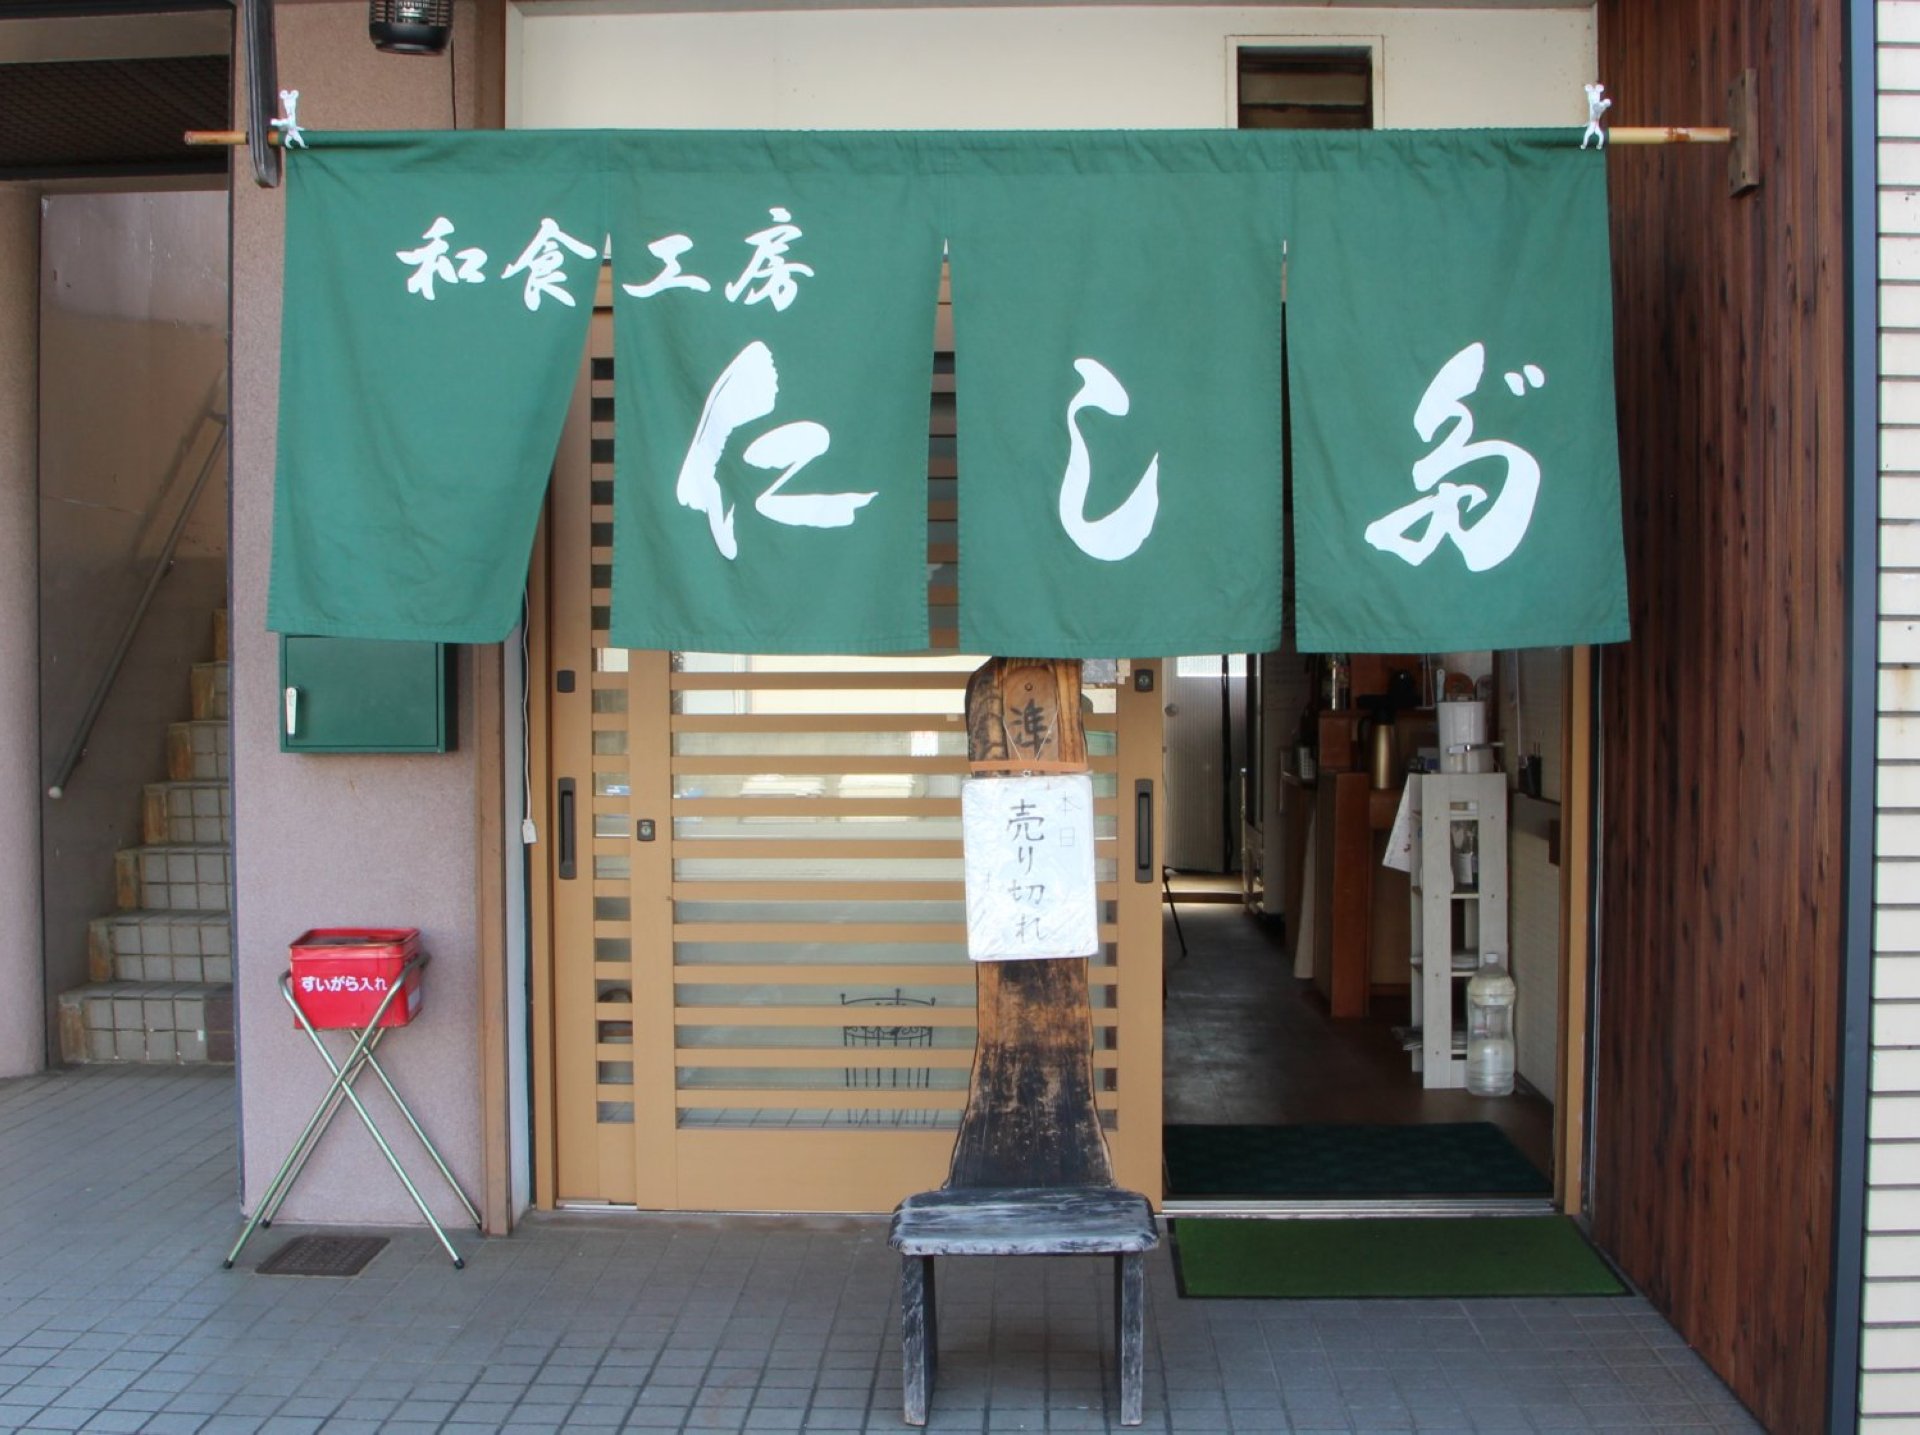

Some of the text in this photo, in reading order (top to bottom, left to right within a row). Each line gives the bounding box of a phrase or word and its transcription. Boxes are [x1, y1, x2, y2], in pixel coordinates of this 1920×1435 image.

[396, 207, 815, 311] 和食工房
[1006, 798, 1049, 943] 売り切れ
[301, 976, 388, 993] すいがら入れ
